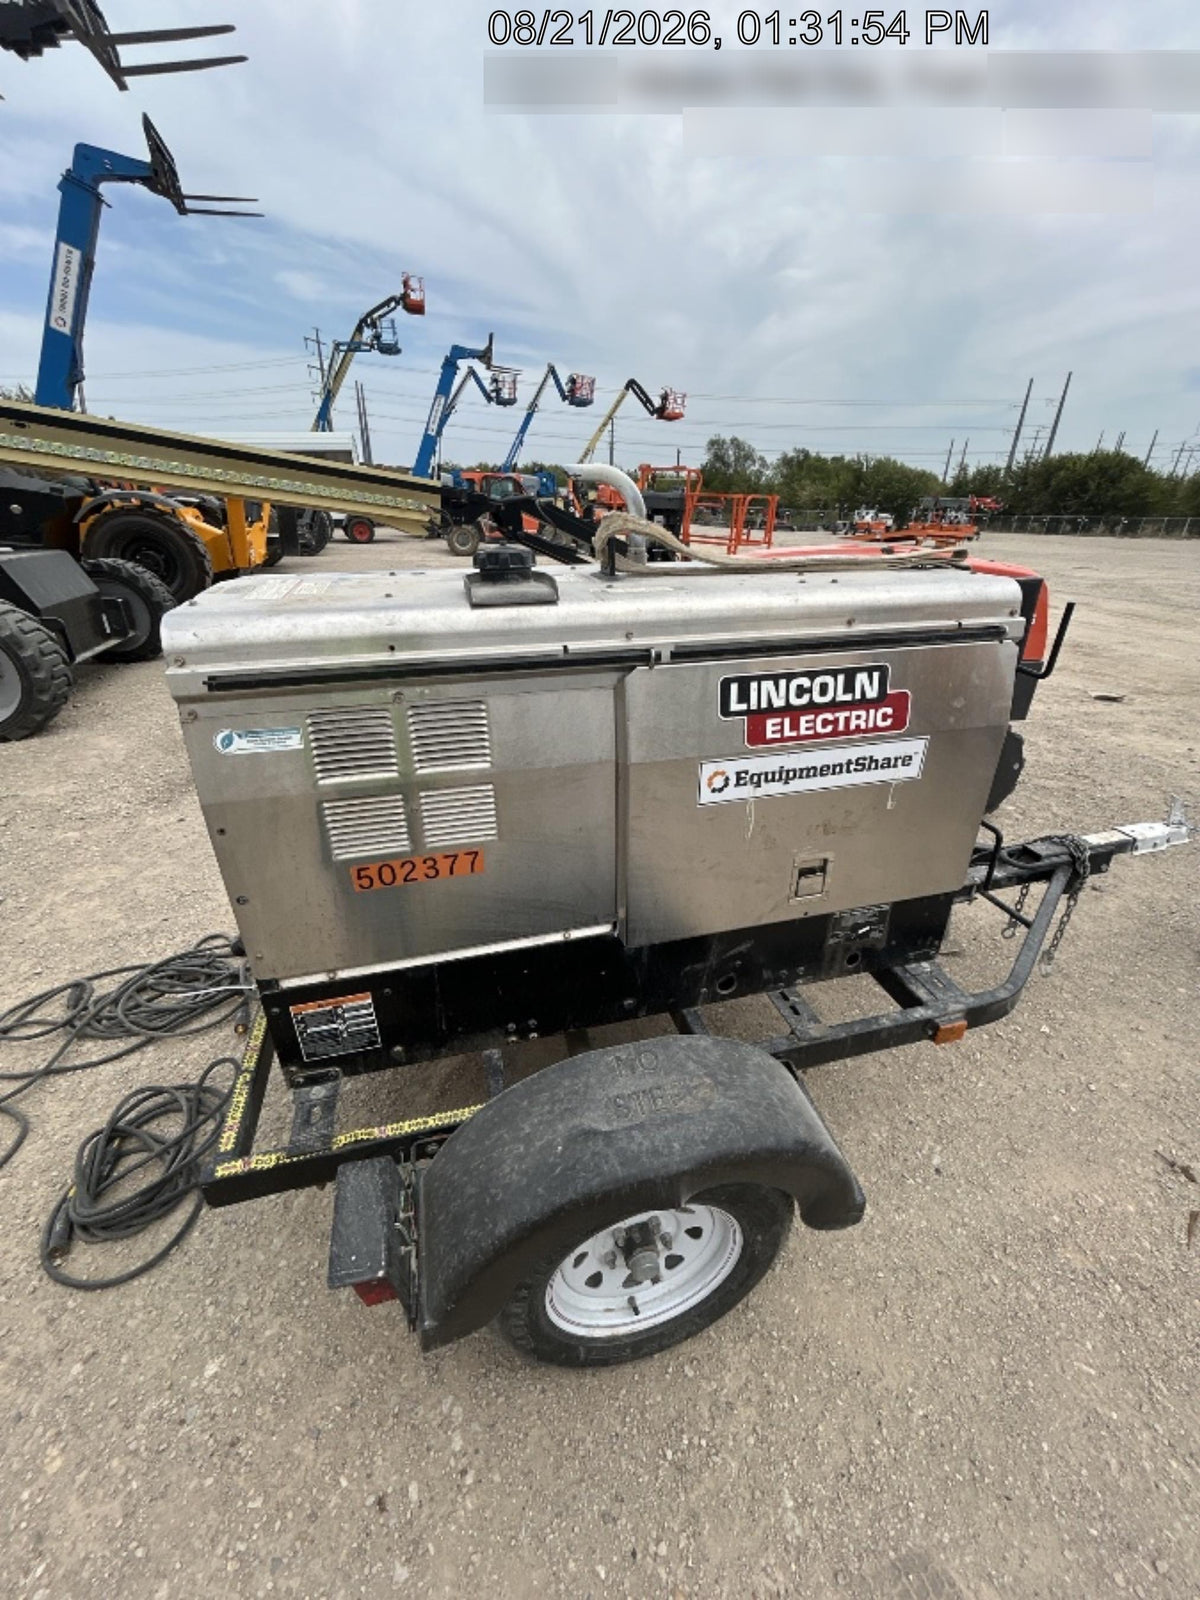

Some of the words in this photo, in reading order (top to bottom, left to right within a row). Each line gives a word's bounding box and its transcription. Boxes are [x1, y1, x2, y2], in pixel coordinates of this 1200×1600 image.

[729, 670, 881, 712] LINCOLN
[765, 706, 894, 740] ELECTRIC
[733, 754, 913, 789] EquipmentShare
[355, 850, 480, 890] 502377
